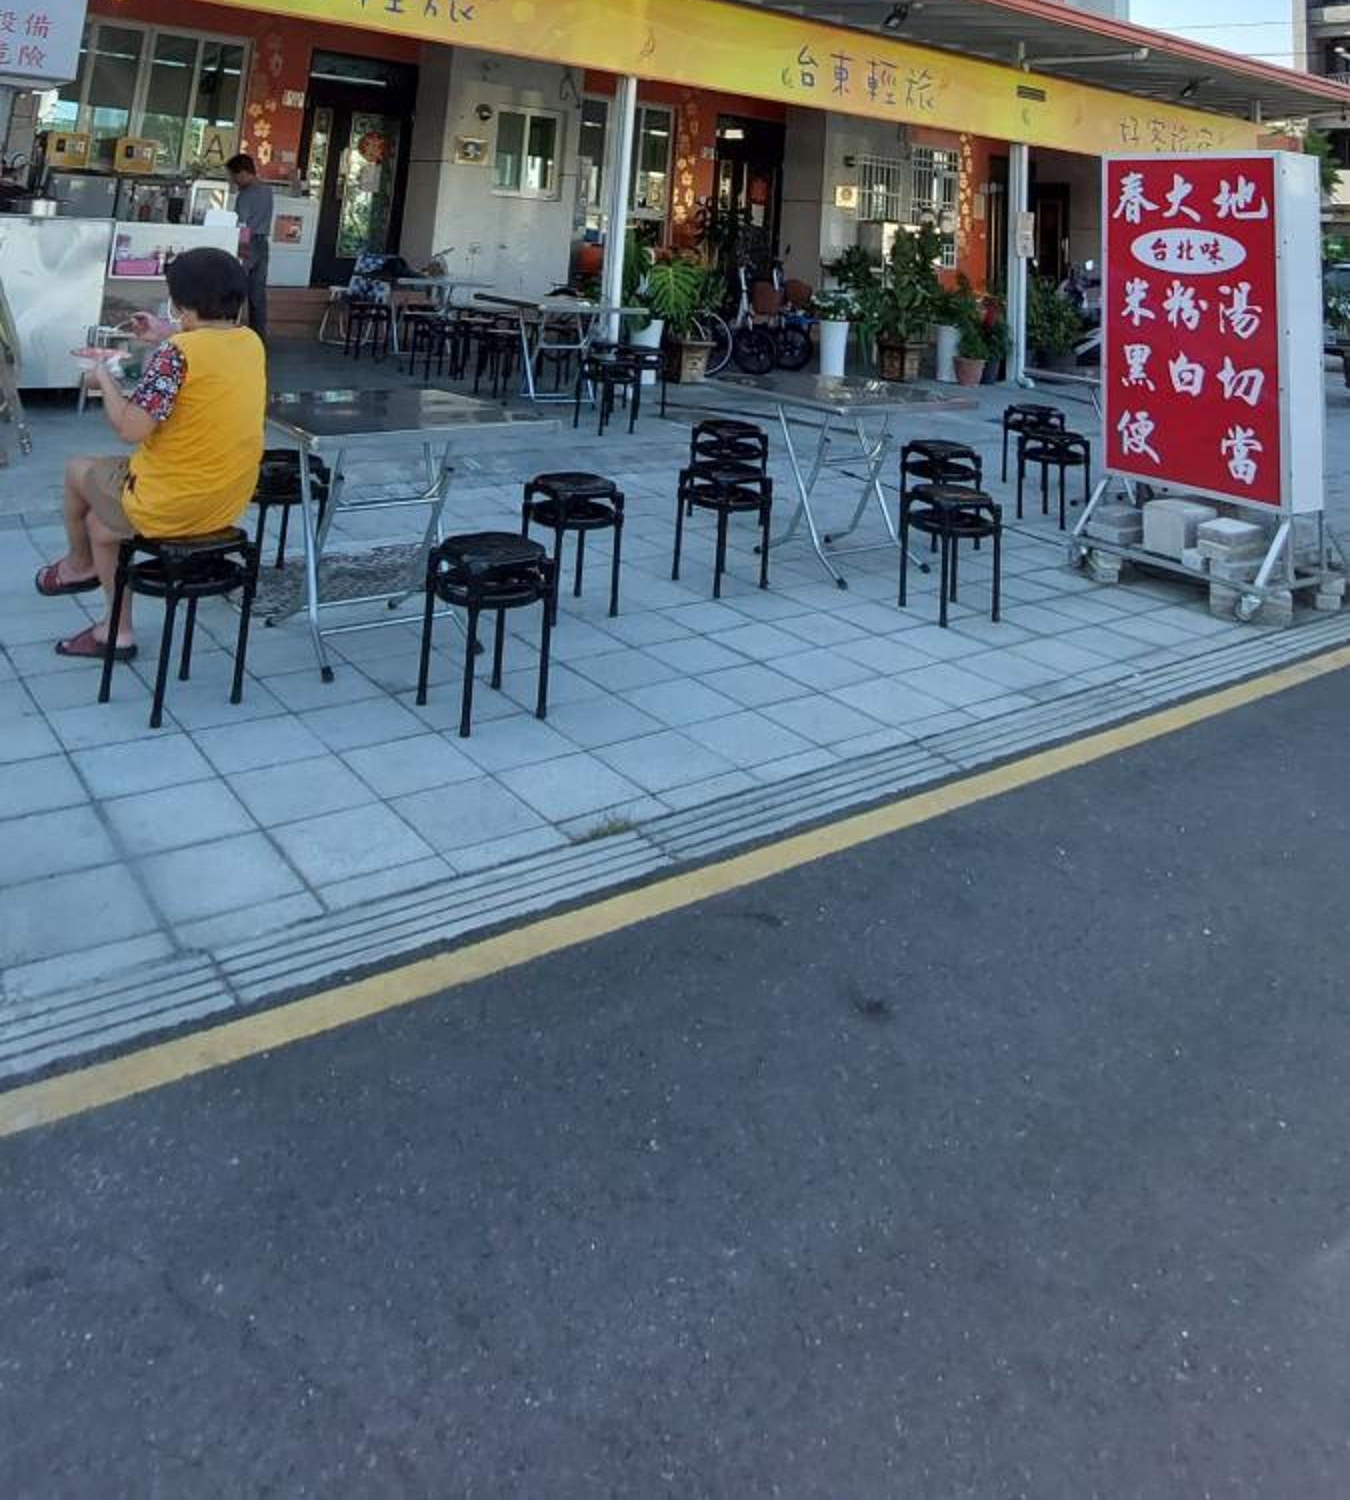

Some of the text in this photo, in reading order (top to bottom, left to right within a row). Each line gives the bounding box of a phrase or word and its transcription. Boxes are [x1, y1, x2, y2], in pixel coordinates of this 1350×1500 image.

[797, 44, 935, 109] 台東輕旅
[1113, 171, 1269, 224] 春大地
[1149, 238, 1225, 265] 台北味
[1121, 277, 1263, 340] 米粉湯
[1121, 344, 1264, 407] 黑白切
[1117, 409, 1263, 486] 便當
